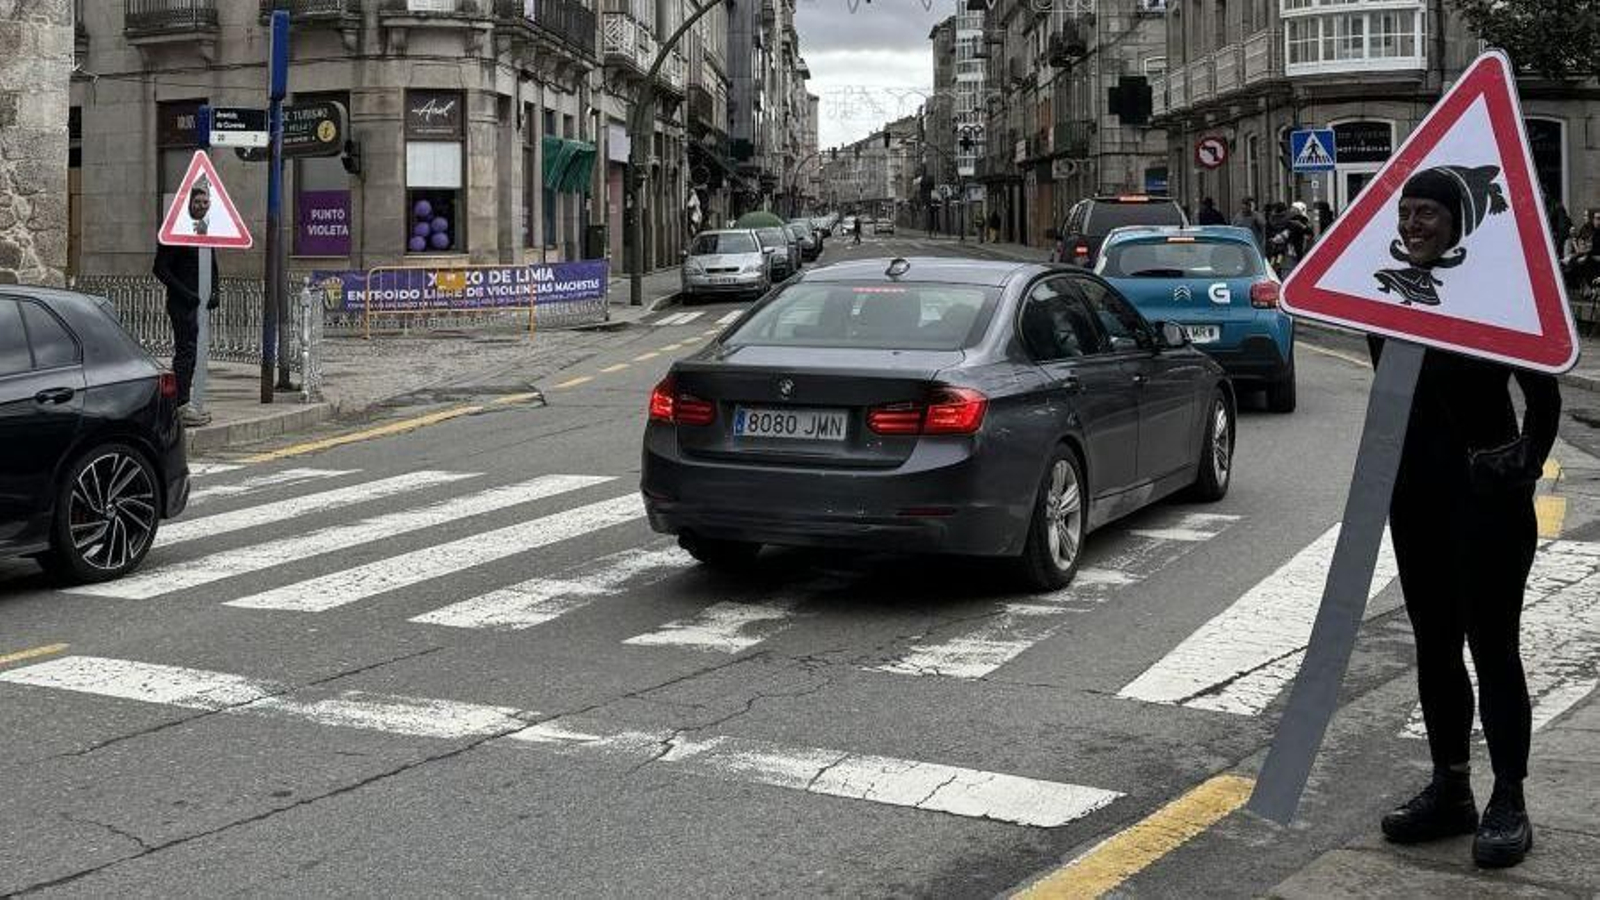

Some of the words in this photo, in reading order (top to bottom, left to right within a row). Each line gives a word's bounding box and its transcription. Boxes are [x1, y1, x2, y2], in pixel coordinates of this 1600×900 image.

[311, 208, 345, 220] PUNTO
[307, 224, 348, 236] VIOLETA
[489, 269, 511, 284] DE
[516, 267, 555, 282] LIMIA
[347, 288, 420, 302] ENTROIDO
[466, 285, 484, 298] DE
[487, 281, 553, 297] VIOLENCIAS
[555, 278, 600, 292] MACHISTAS
[748, 413, 797, 434] 8080
[804, 415, 843, 437] JMN
